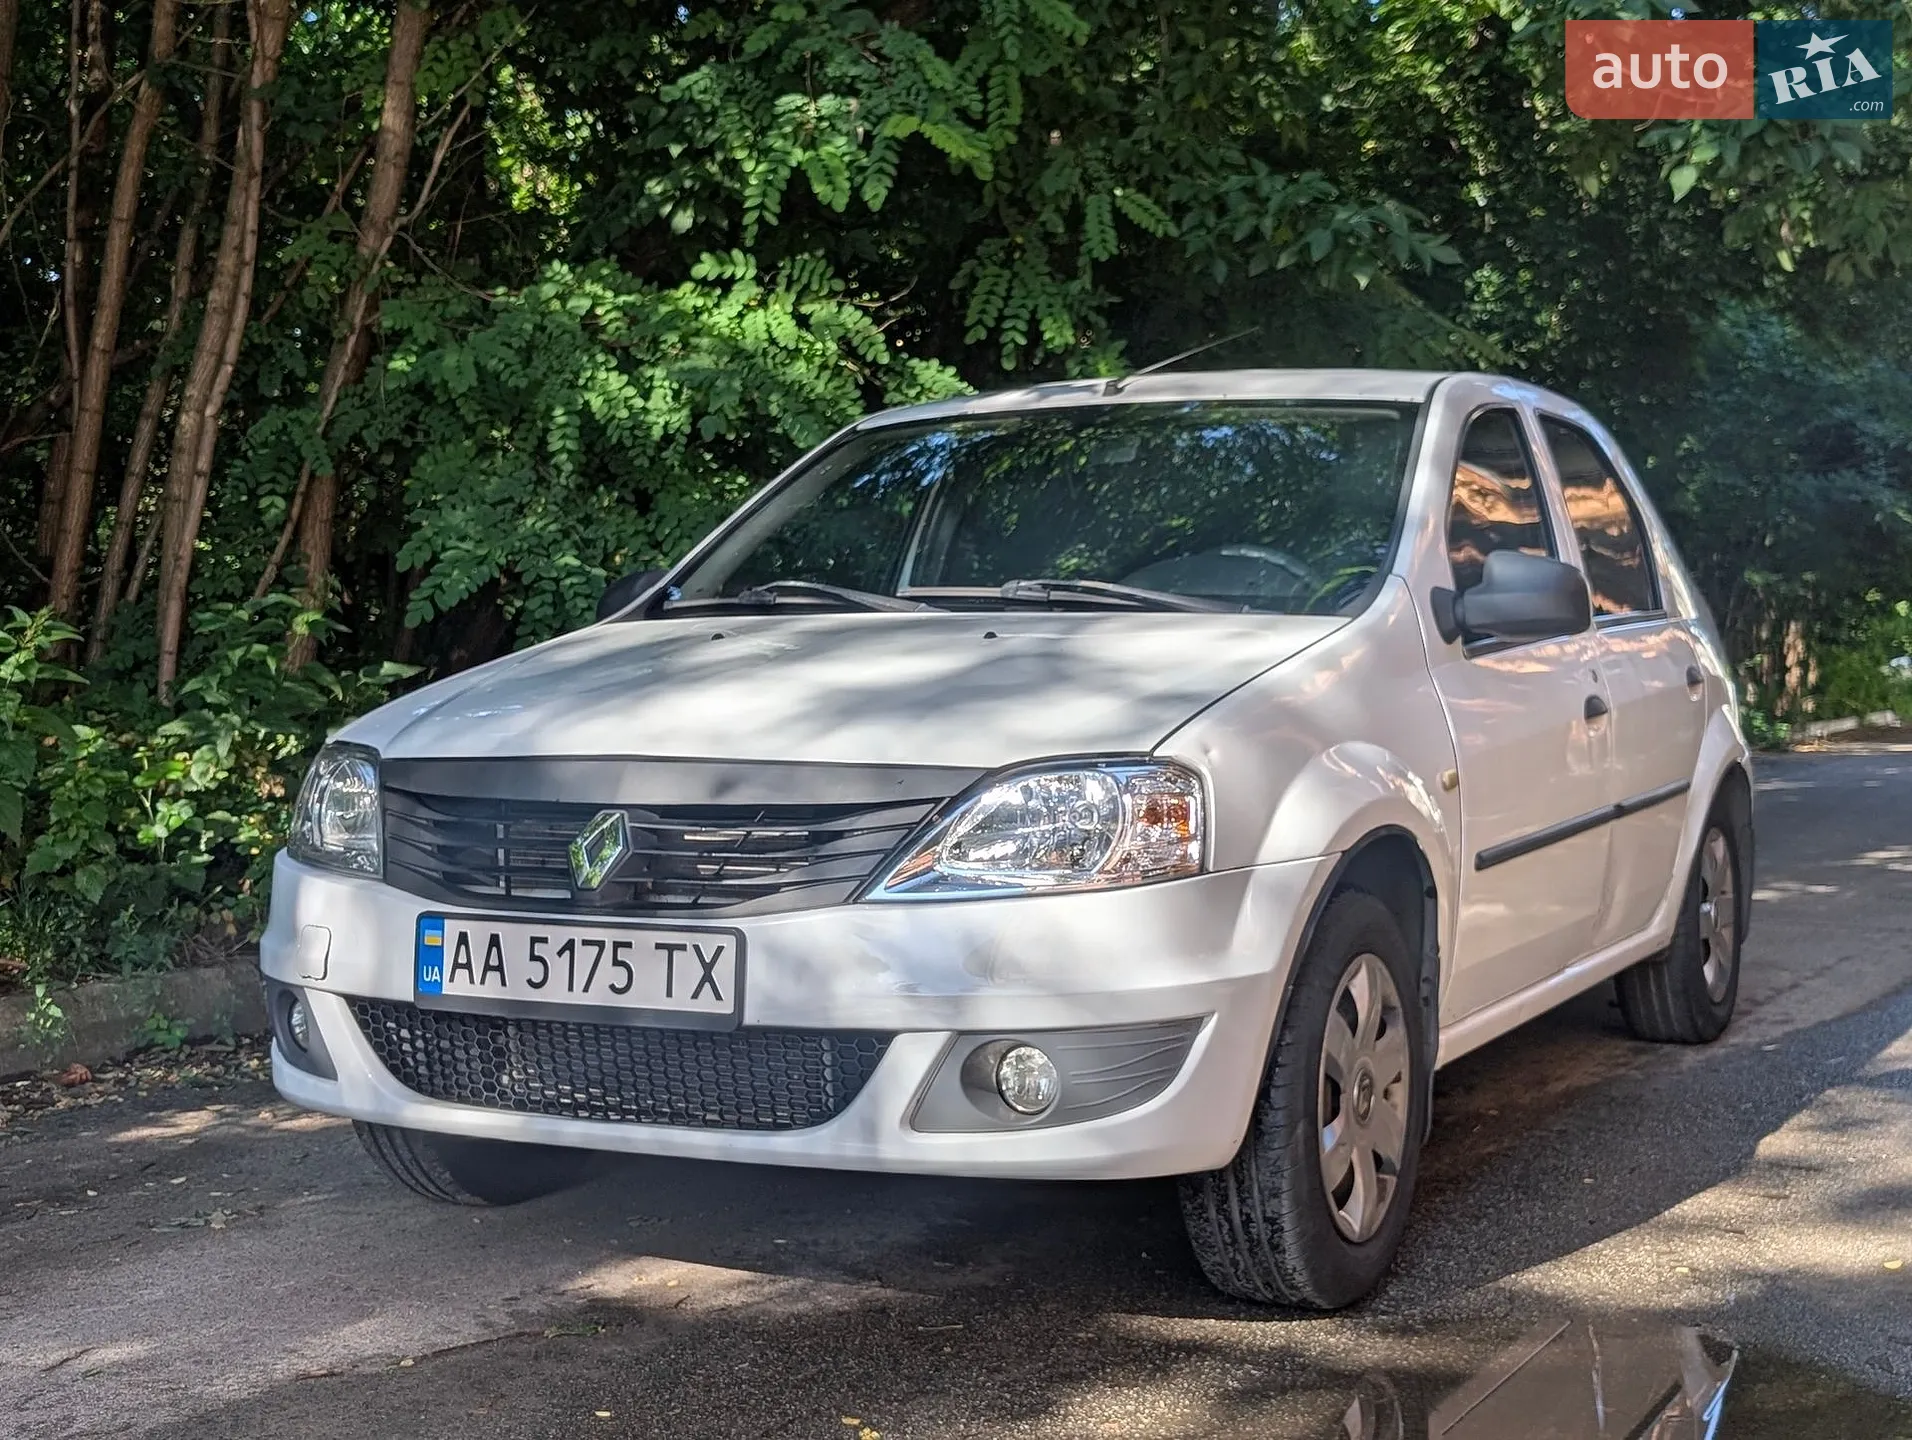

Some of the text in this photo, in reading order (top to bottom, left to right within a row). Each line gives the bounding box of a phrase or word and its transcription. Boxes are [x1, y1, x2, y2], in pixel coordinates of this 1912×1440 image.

[423, 965, 441, 983] UA
[448, 930, 726, 1001] AA 5175 TX
